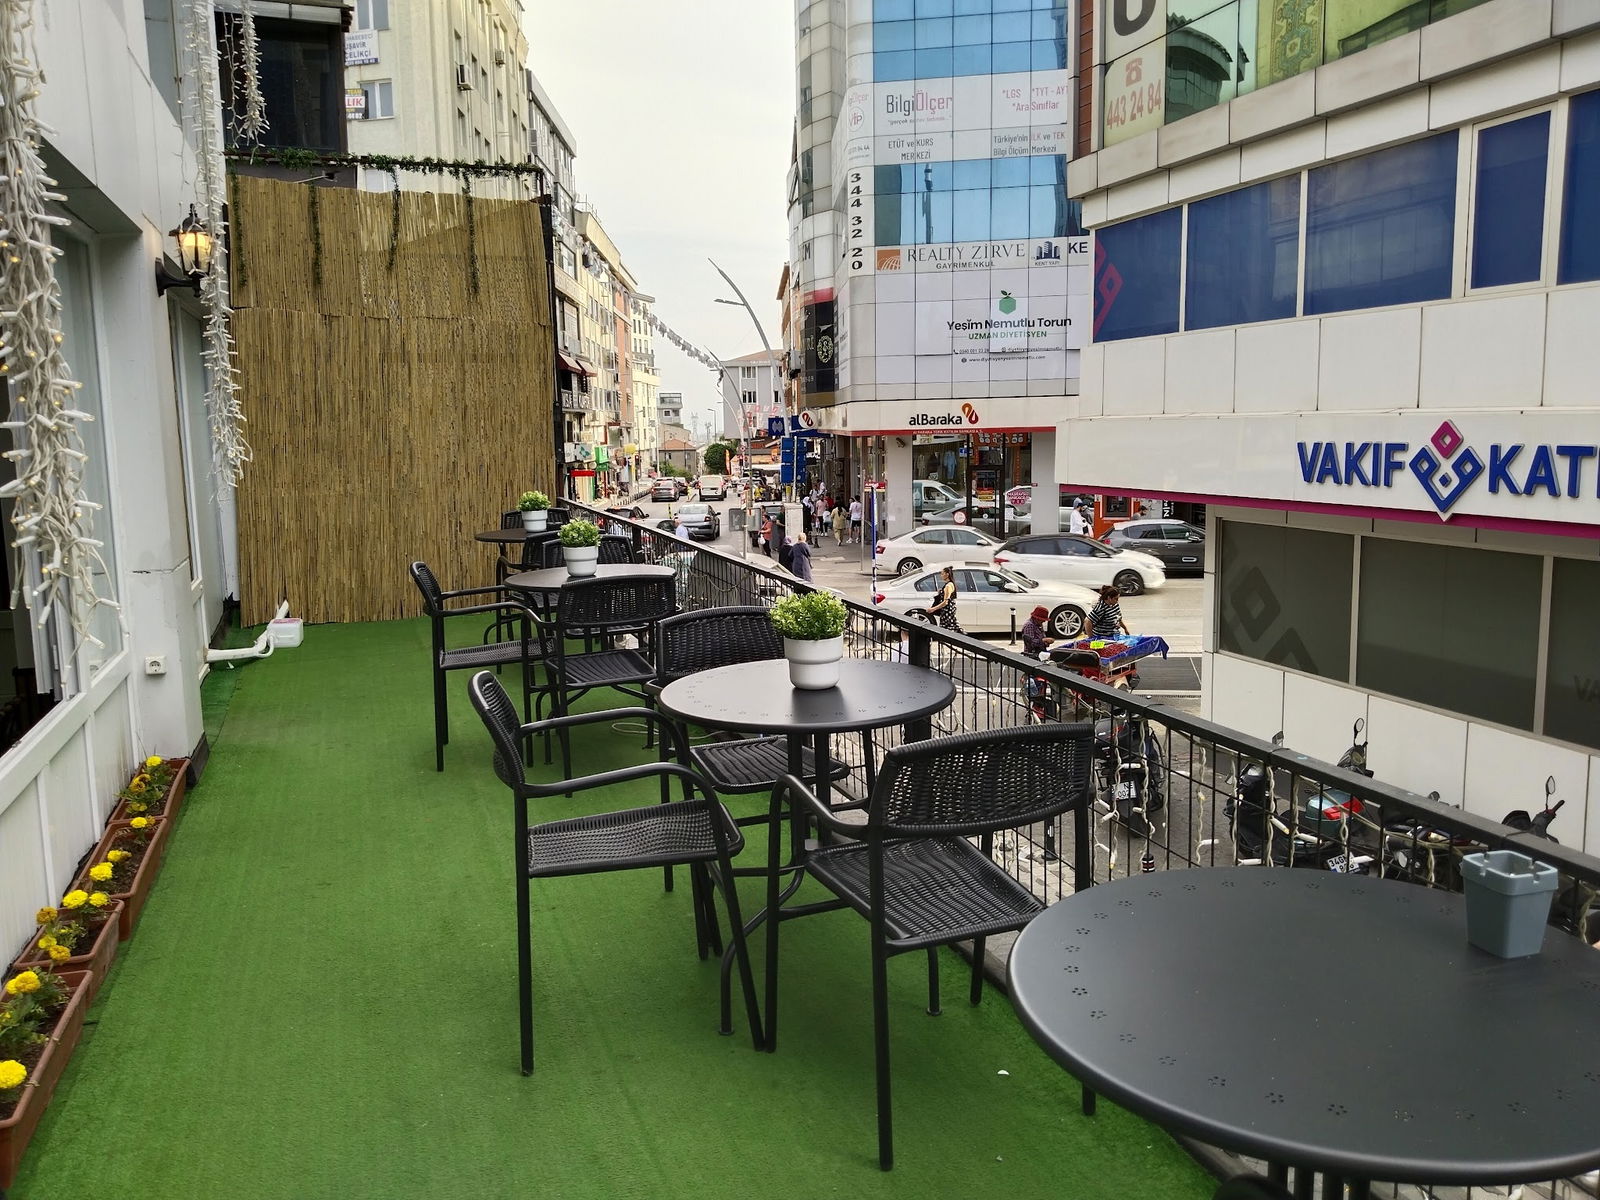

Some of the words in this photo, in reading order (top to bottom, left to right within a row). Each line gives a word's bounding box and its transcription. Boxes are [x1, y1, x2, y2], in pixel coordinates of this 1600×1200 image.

[1106, 95, 1126, 130] 443
[1130, 87, 1143, 121] 24
[1148, 79, 1161, 114] 84
[1053, 131, 1066, 140] TEK
[916, 138, 934, 147] KURS
[907, 246, 965, 262] REALTY
[971, 243, 1026, 259] ZİRVE
[1067, 241, 1088, 255] KE
[984, 317, 1035, 330] Nemutlu
[1037, 317, 1072, 328] Torun
[968, 331, 998, 340] UZMAN
[908, 413, 963, 426] alBaraka
[1297, 441, 1409, 488] VAKIF
